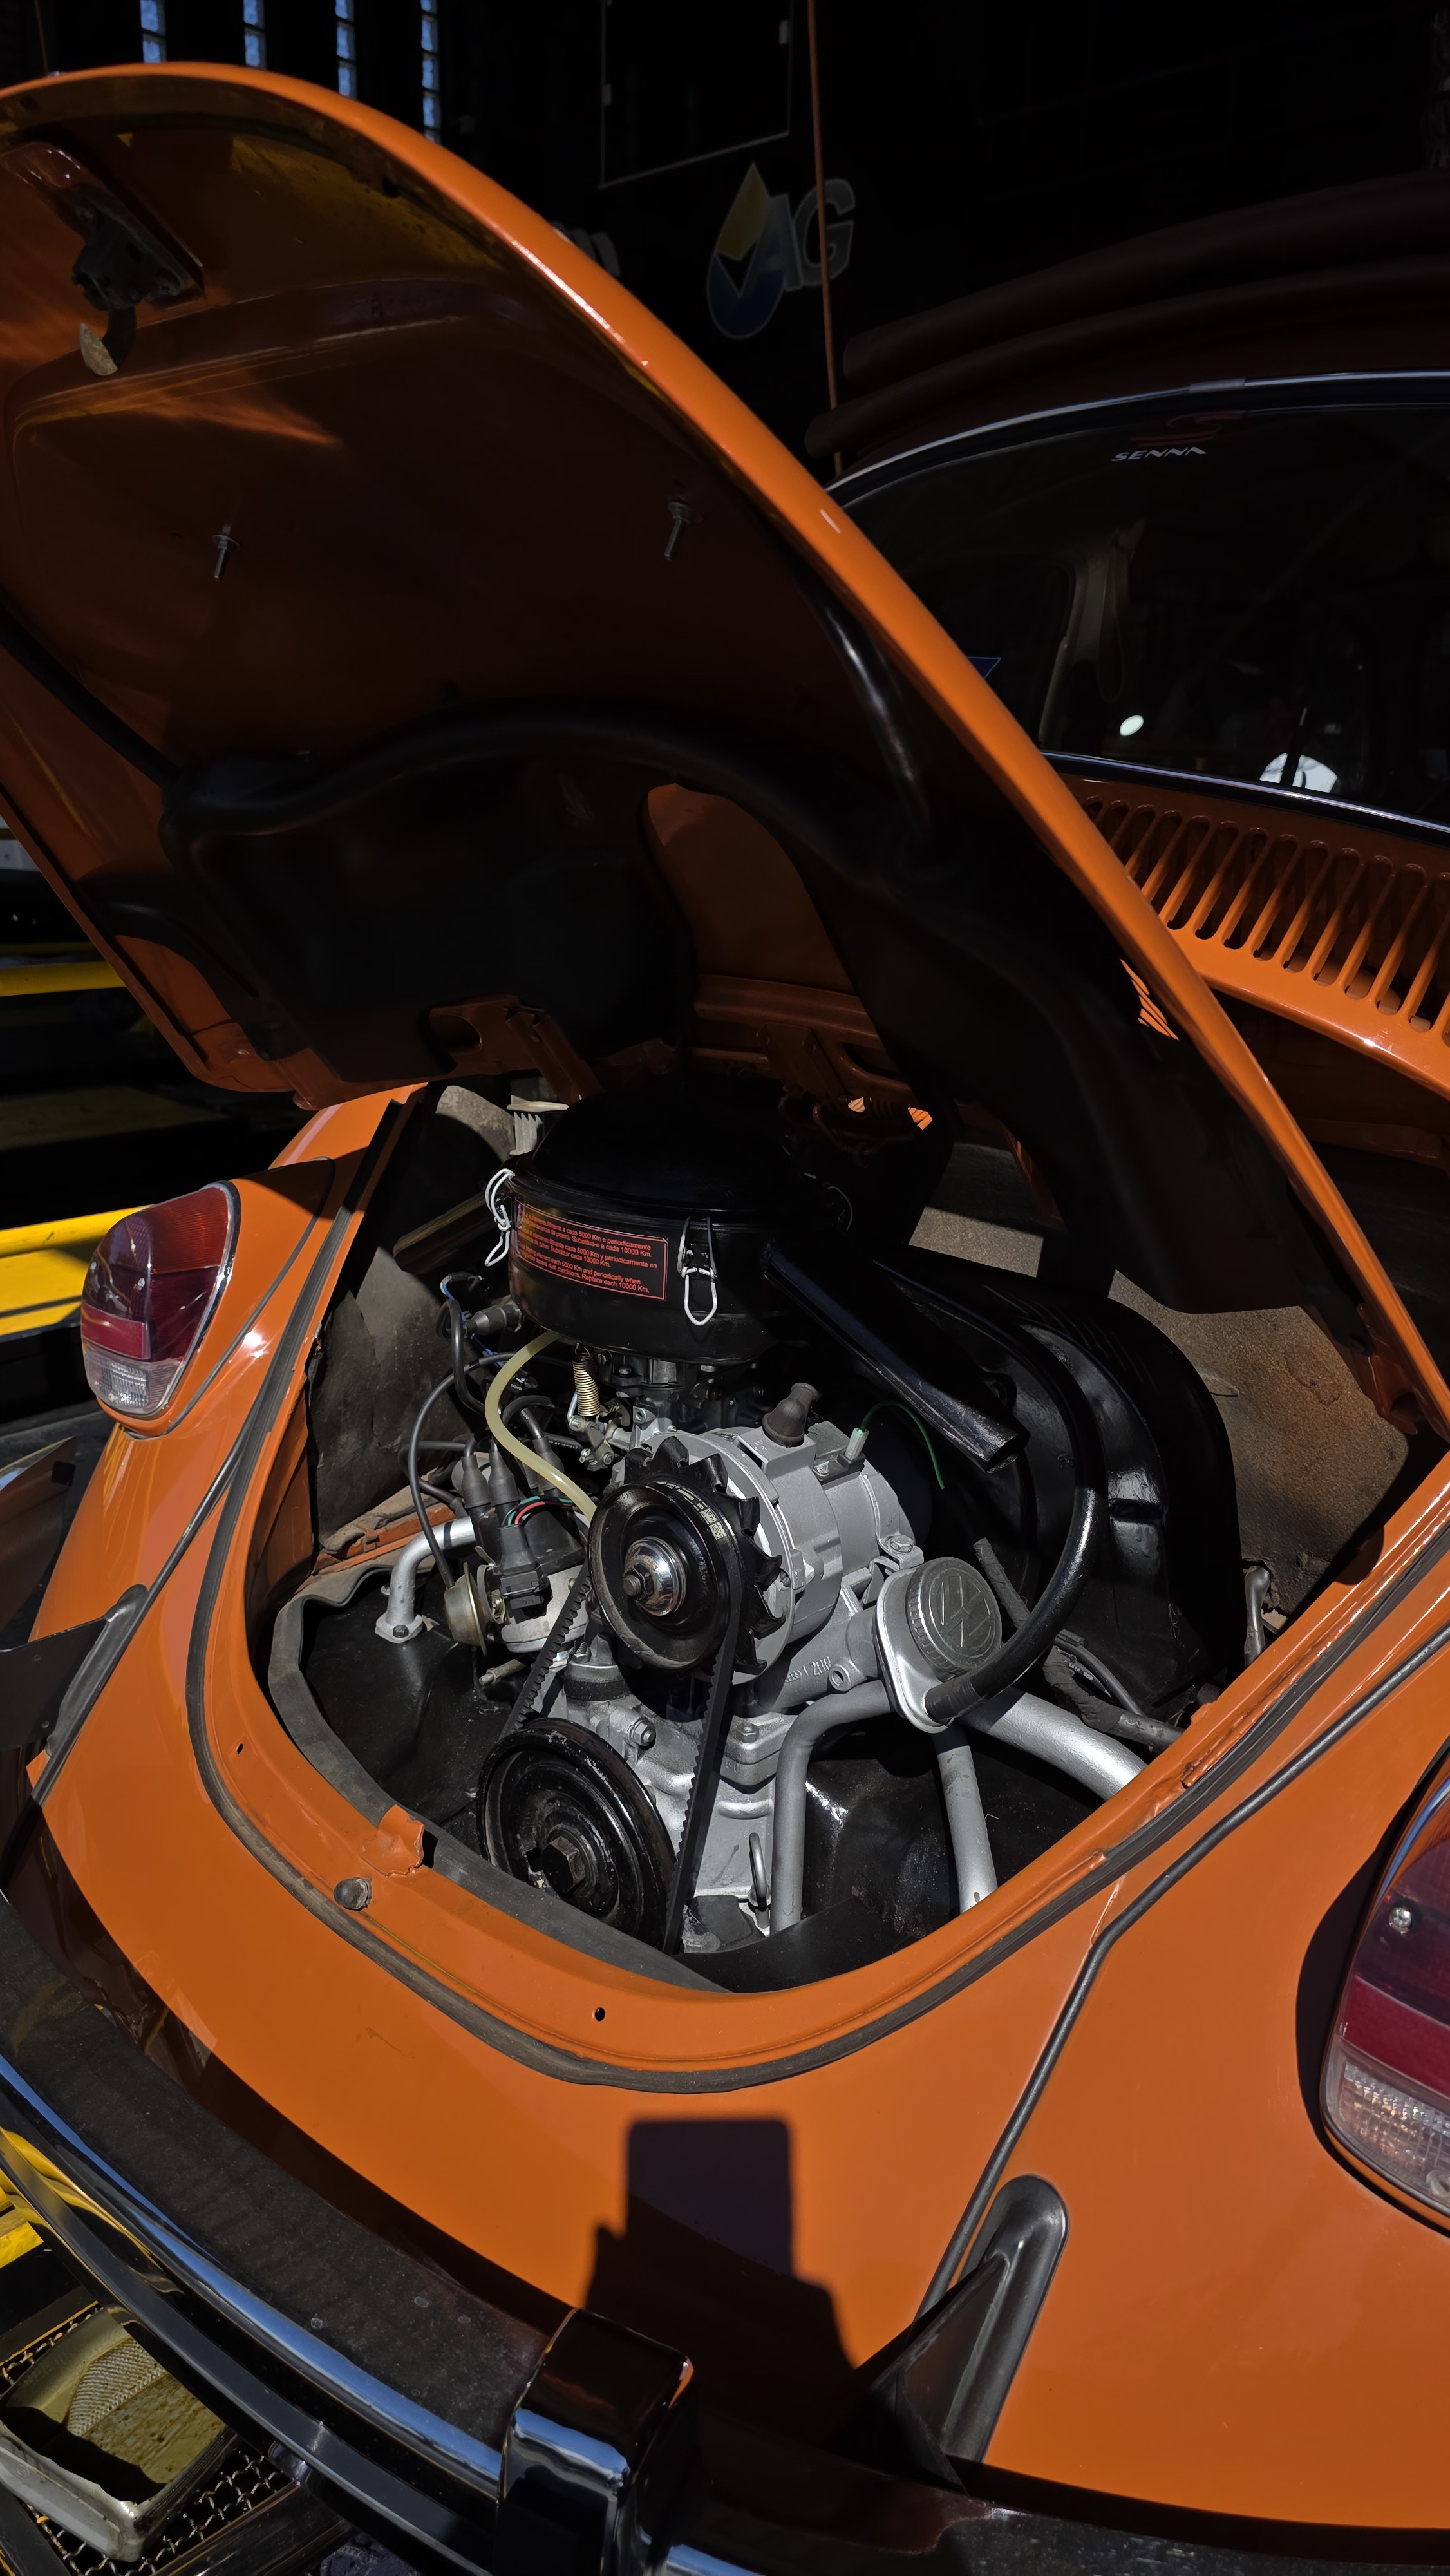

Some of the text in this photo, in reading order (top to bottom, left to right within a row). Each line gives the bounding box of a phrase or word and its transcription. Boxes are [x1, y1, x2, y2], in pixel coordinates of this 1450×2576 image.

[1111, 446, 1207, 468] SENNA
[607, 1239, 651, 1251] periodicamente
[577, 1247, 589, 1256] 5000
[605, 1255, 648, 1267] periodicamente
[584, 1256, 599, 1265] 10000
[558, 1267, 581, 1278] conditions.
[582, 1274, 603, 1283] Replace
[594, 1271, 624, 1283] periodically
